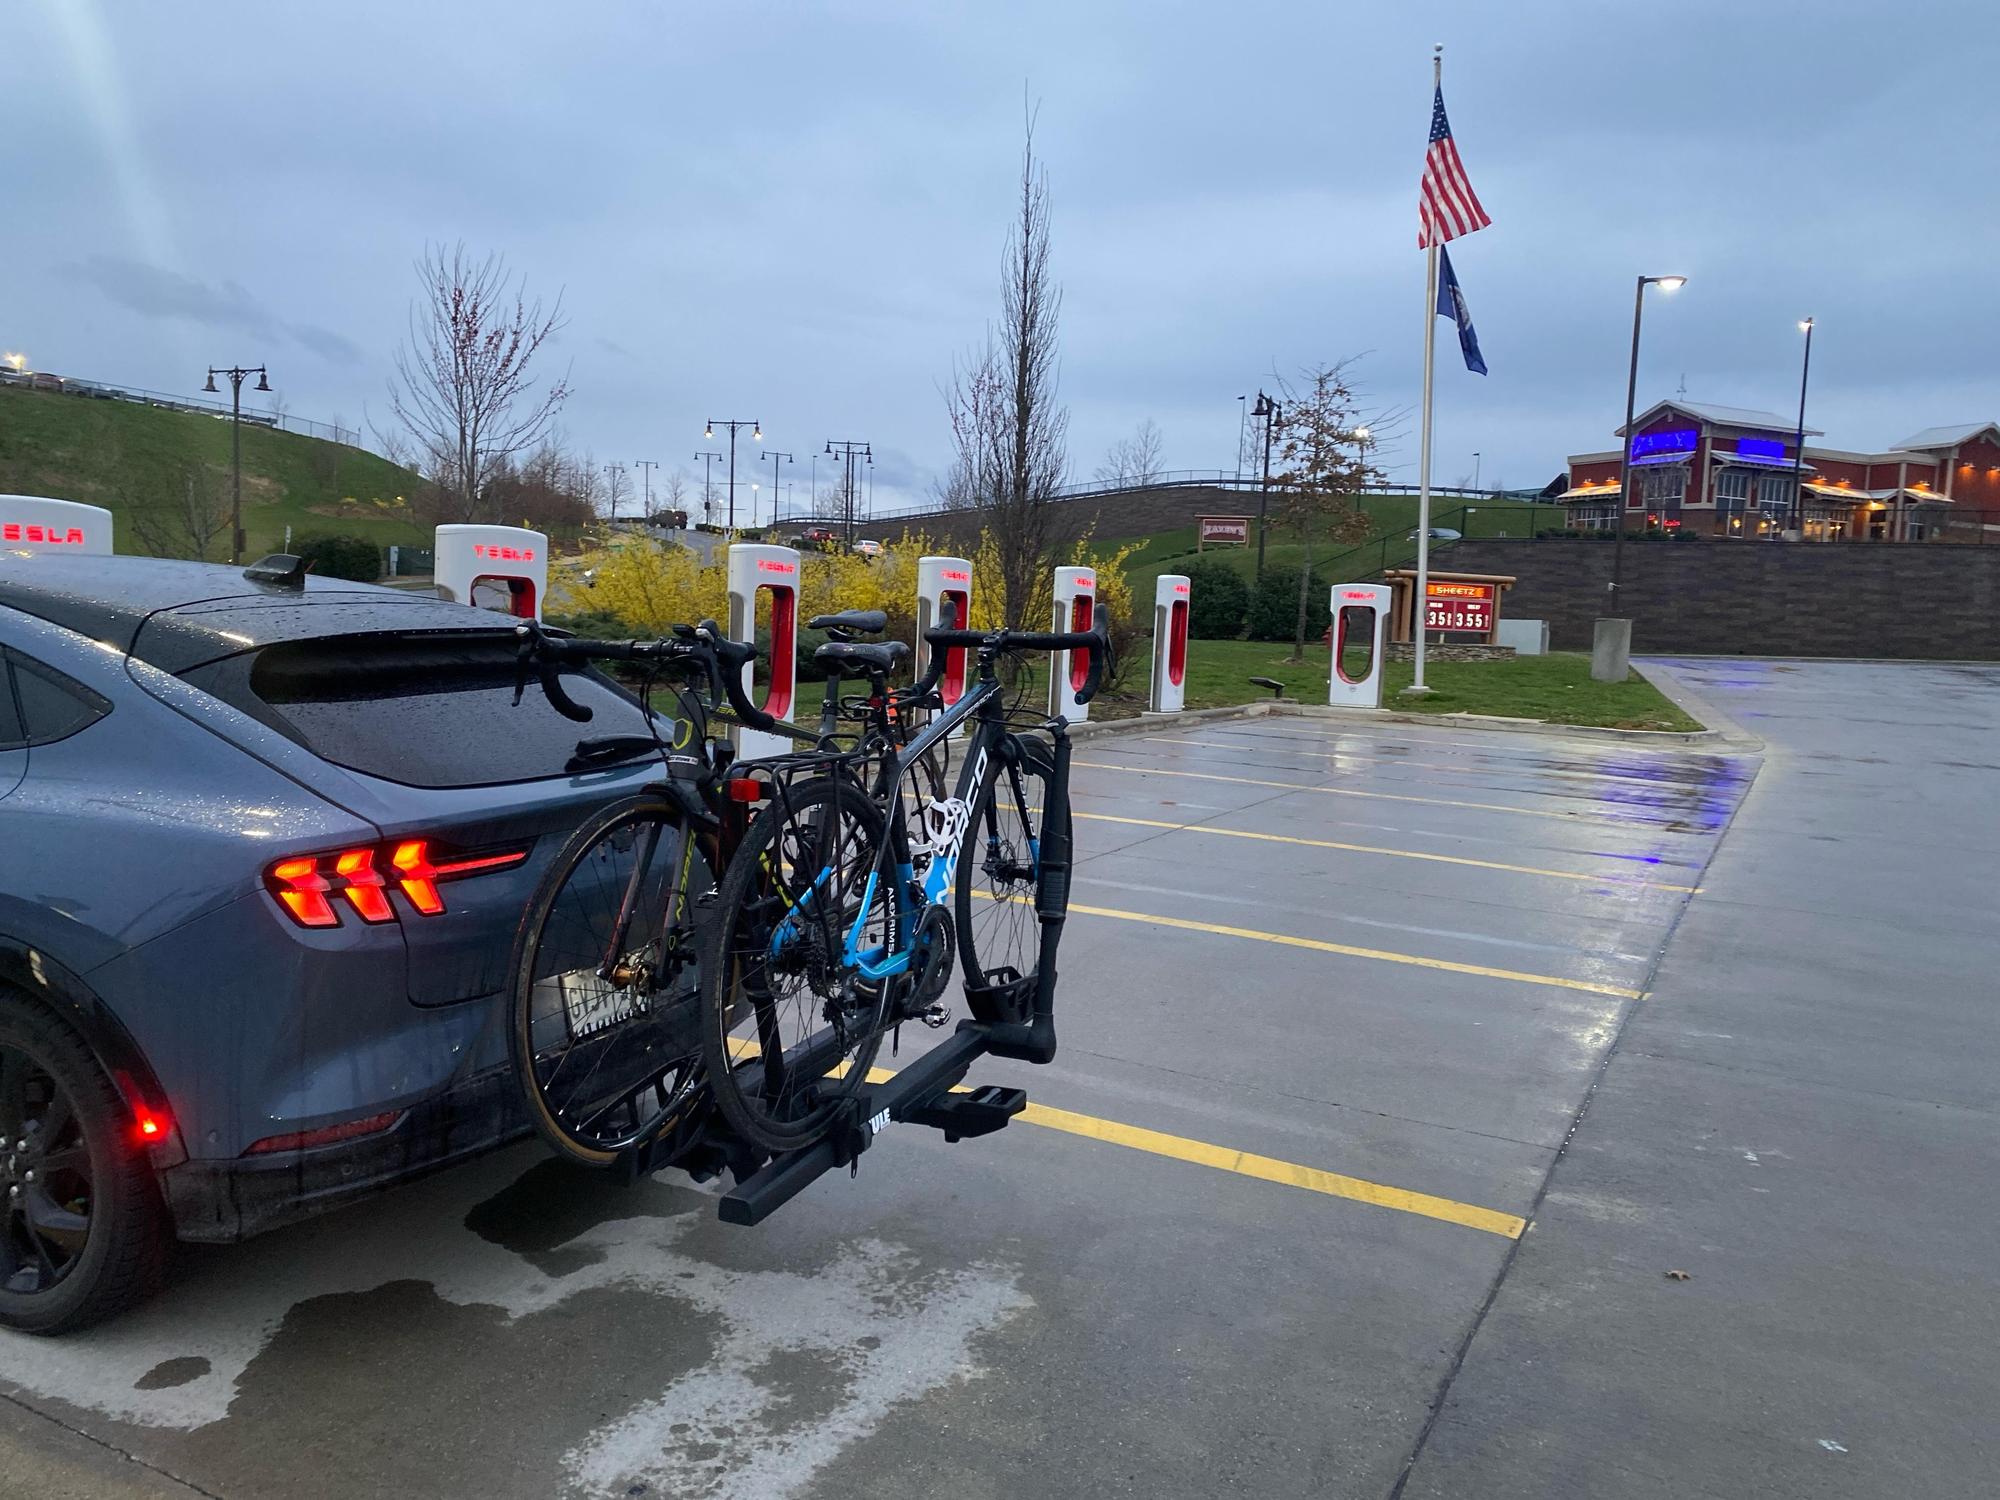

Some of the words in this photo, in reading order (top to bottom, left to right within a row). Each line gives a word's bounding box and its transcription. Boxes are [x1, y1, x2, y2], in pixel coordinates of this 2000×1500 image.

[2, 523, 84, 545] ESLA
[474, 544, 534, 562] TESLA
[1436, 586, 1476, 596] SHEETZ
[935, 746, 989, 905] NORCO
[868, 1106, 891, 1135] ULE
